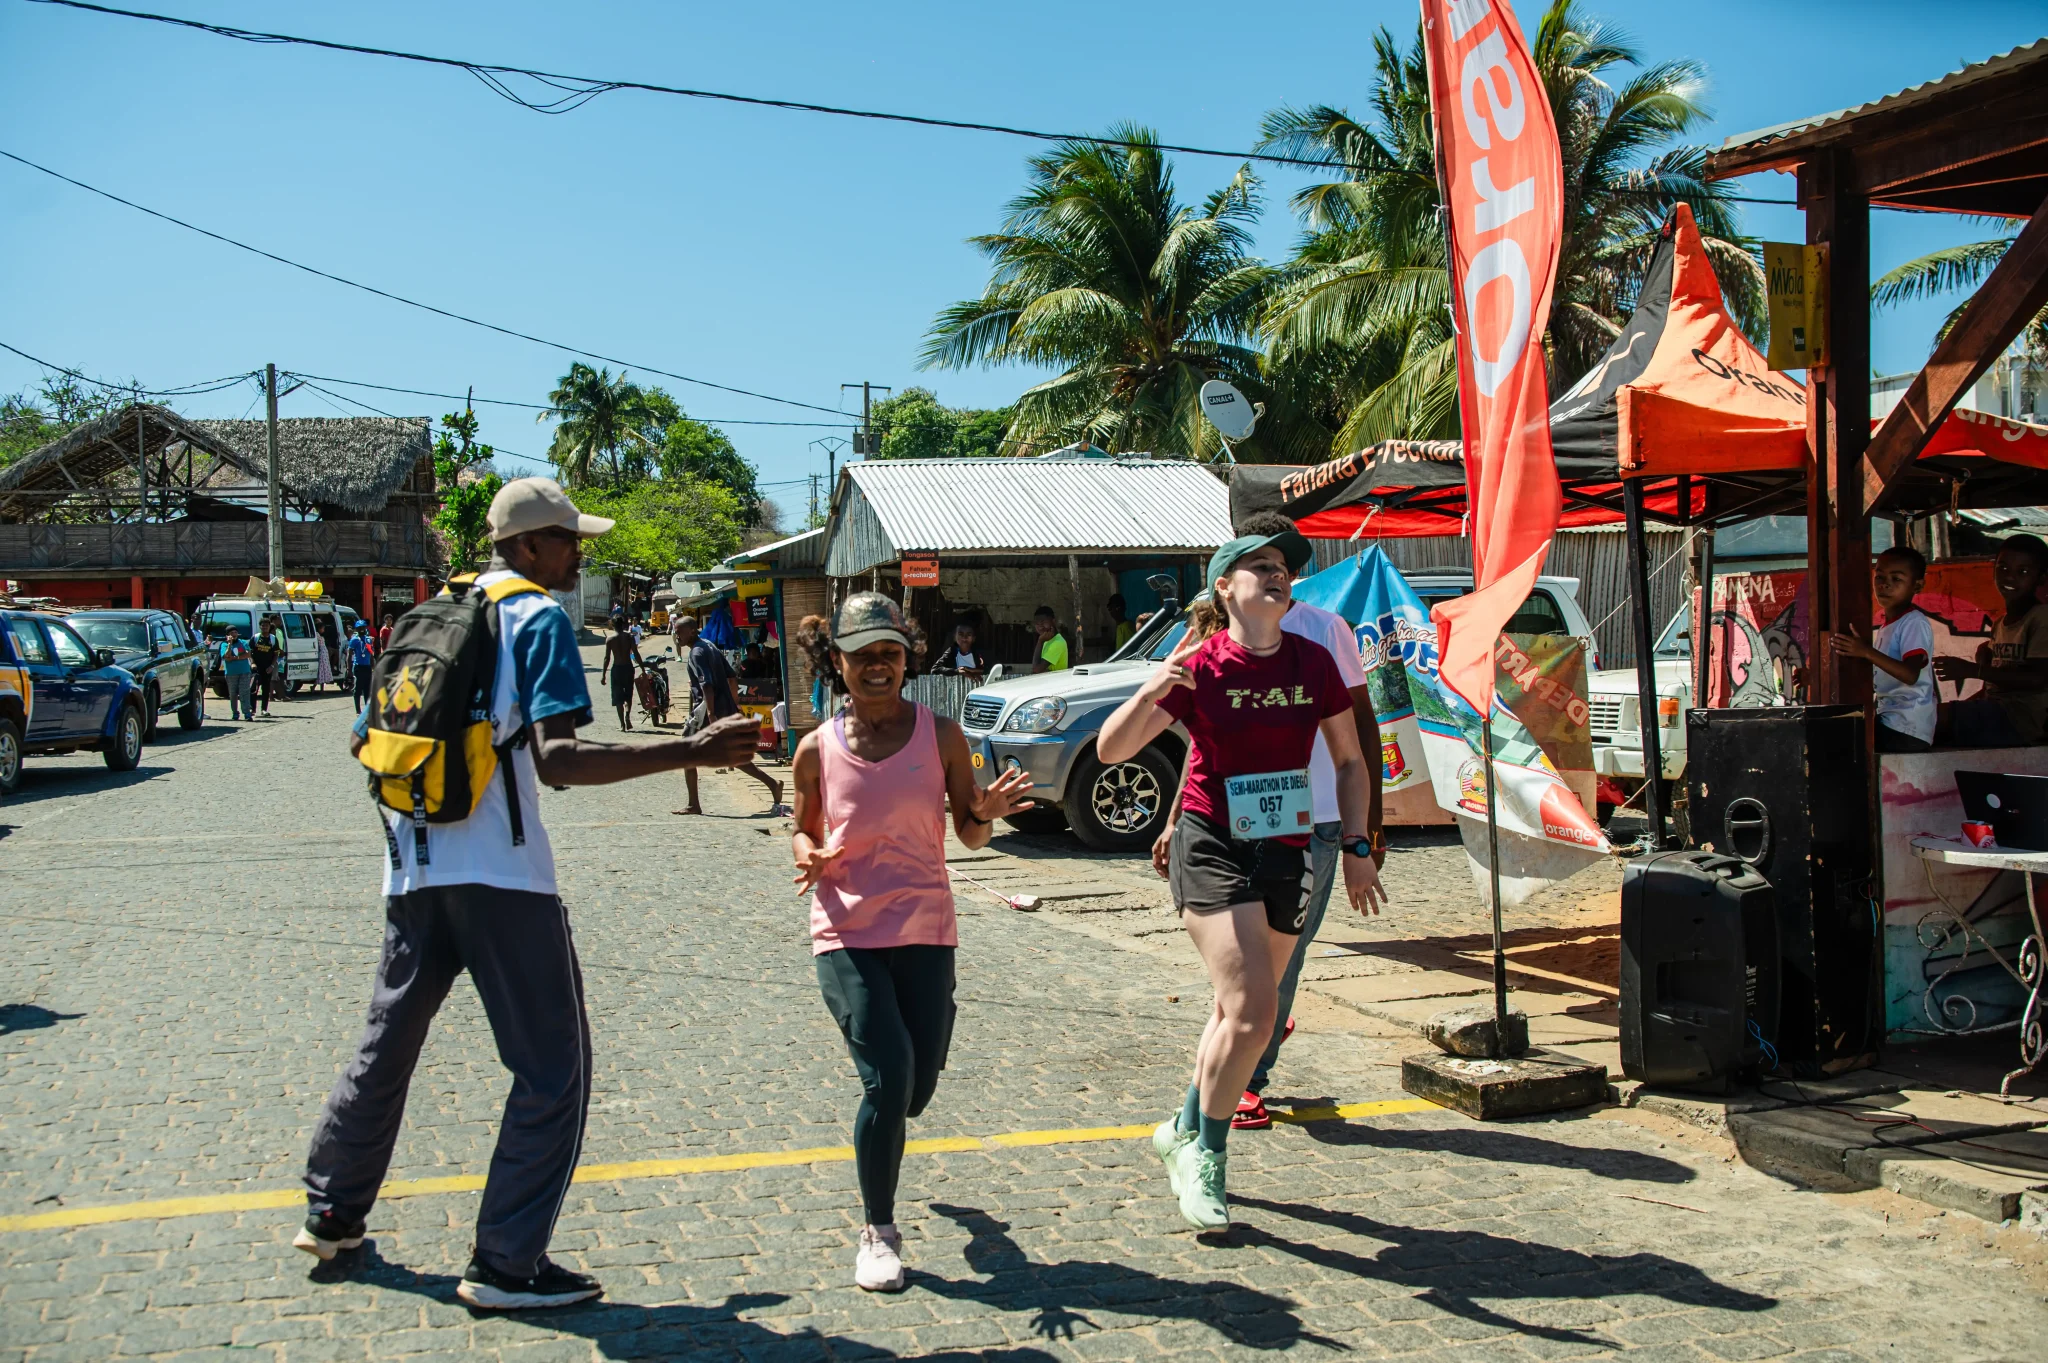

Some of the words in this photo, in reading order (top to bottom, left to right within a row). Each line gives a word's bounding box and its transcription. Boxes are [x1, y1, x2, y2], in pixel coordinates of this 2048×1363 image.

[1208, 394, 1233, 404] CANAL+
[1280, 454, 1358, 502] Fahana
[1226, 685, 1313, 708] TRAIL
[1230, 777, 1280, 796] SEMI-MARATHON
[1281, 776, 1290, 791] DE
[1290, 774, 1309, 789] DIEGO
[1260, 795, 1283, 813] 057
[1545, 823, 1593, 841] orange
